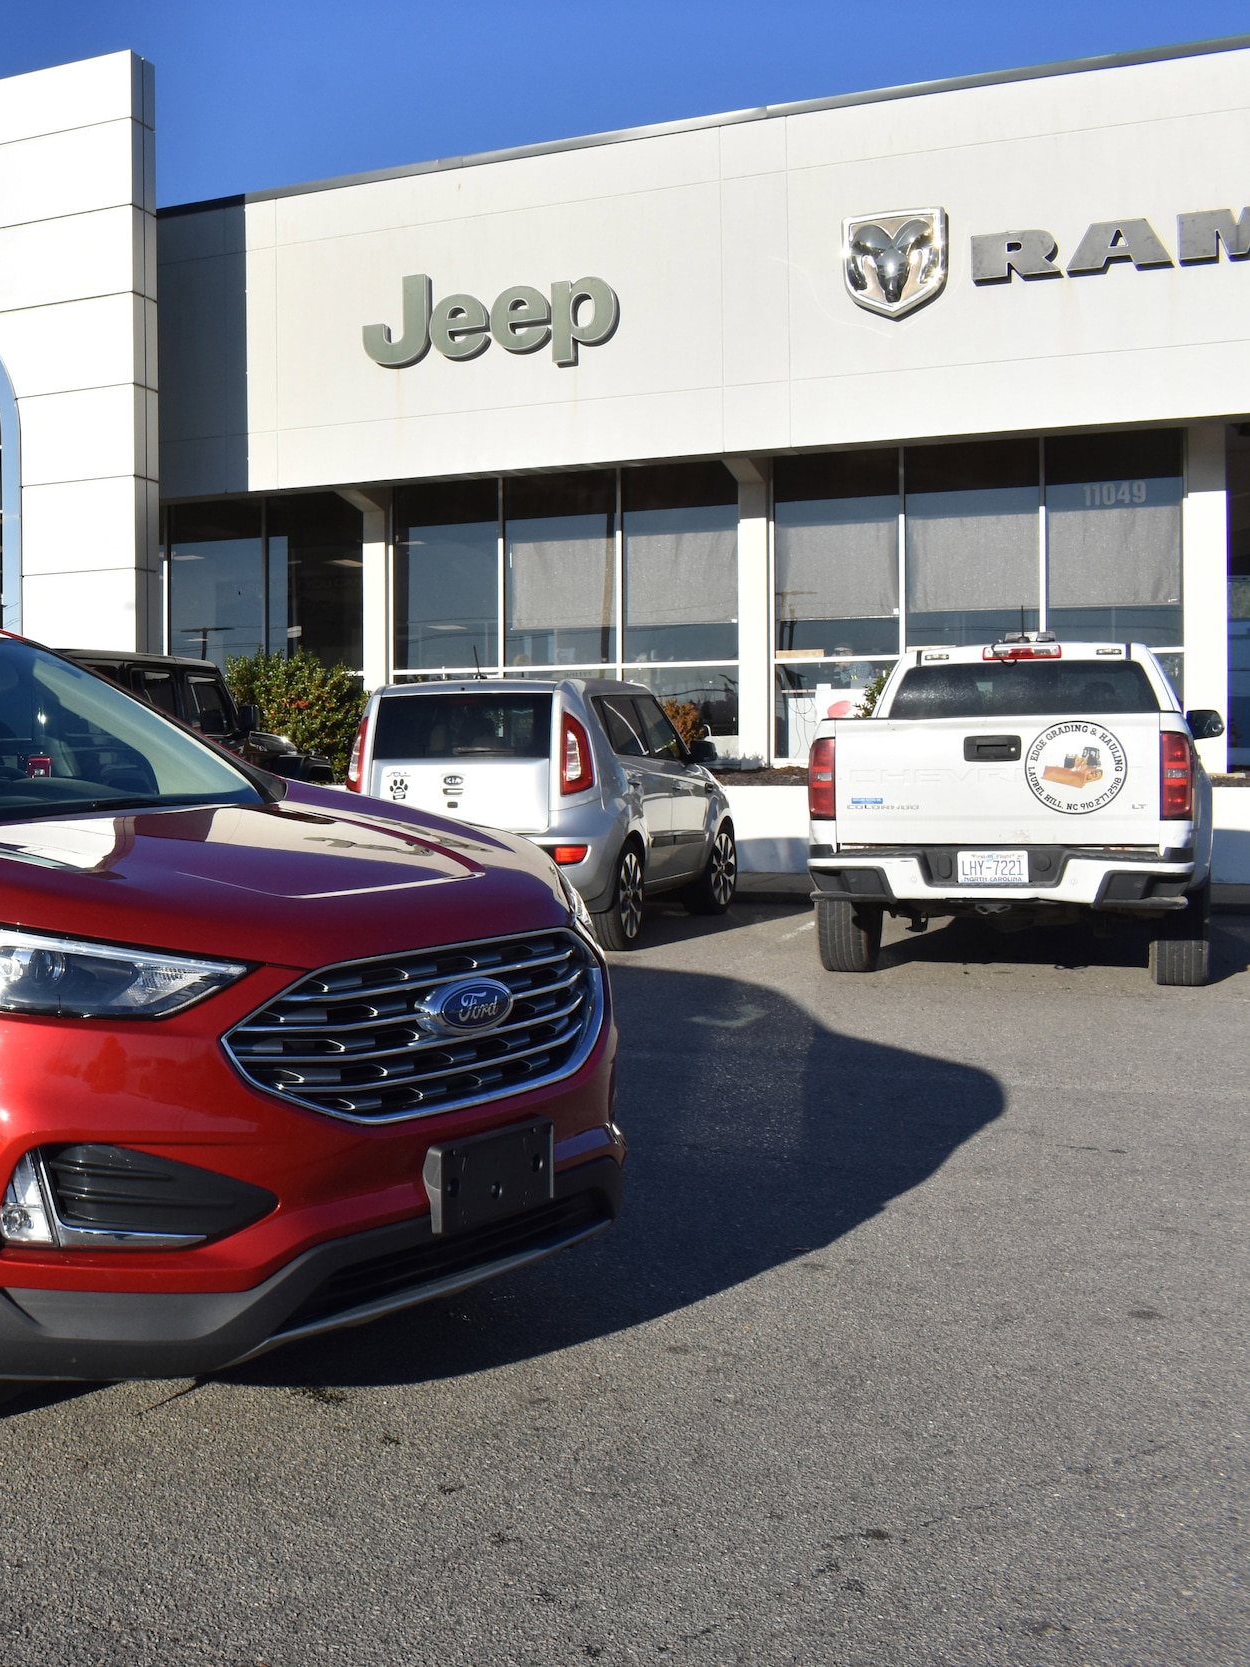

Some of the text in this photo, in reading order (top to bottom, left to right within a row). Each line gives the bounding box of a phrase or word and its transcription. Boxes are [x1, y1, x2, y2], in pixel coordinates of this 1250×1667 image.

[970, 205, 1250, 287] RAM
[362, 273, 621, 369] Jeep
[1083, 481, 1146, 507] 11049
[1030, 724, 1124, 773] EDGE GRADING & HAULING
[1028, 766, 1045, 796] LAUREL
[1066, 803, 1079, 811] NC
[961, 860, 1024, 876] LHY-7221
[458, 991, 498, 1022] Ford
